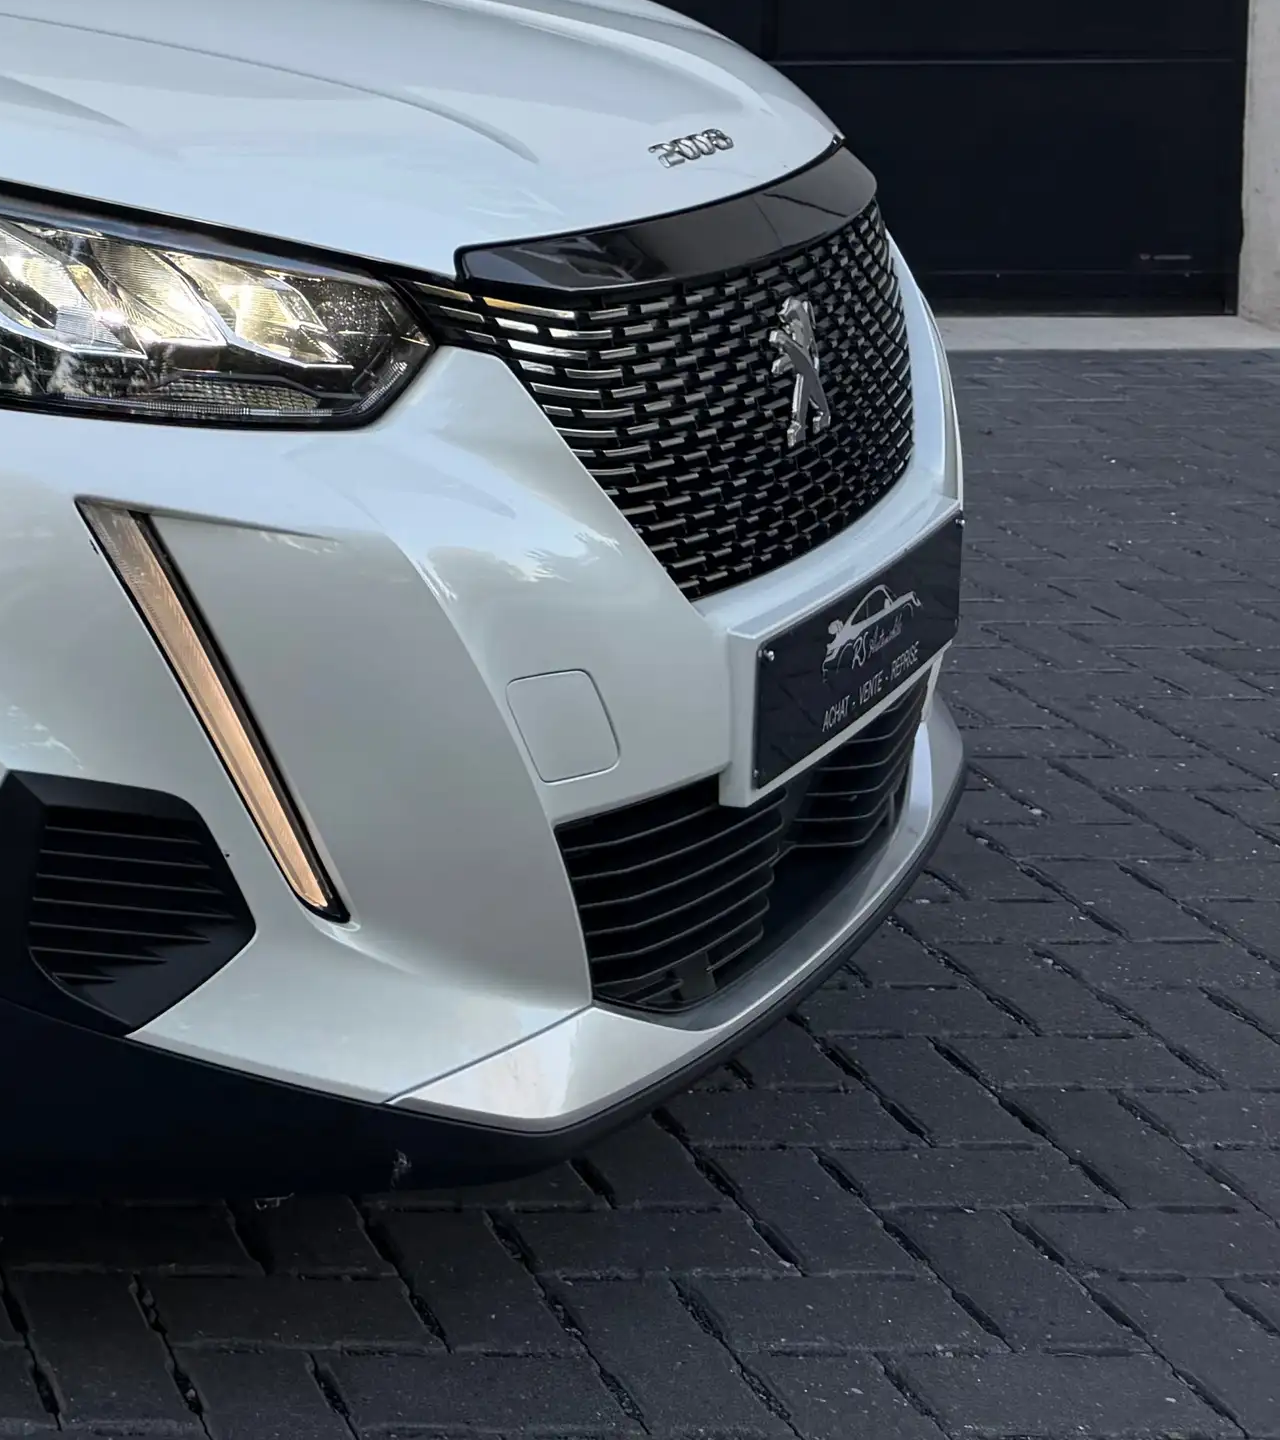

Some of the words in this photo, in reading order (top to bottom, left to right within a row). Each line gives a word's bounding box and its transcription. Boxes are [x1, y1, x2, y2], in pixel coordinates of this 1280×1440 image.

[646, 128, 735, 169] 2008
[852, 632, 869, 670] RS
[822, 693, 852, 732] ACHAT
[859, 670, 884, 705] VENTE
[890, 641, 920, 681] REPRISE
